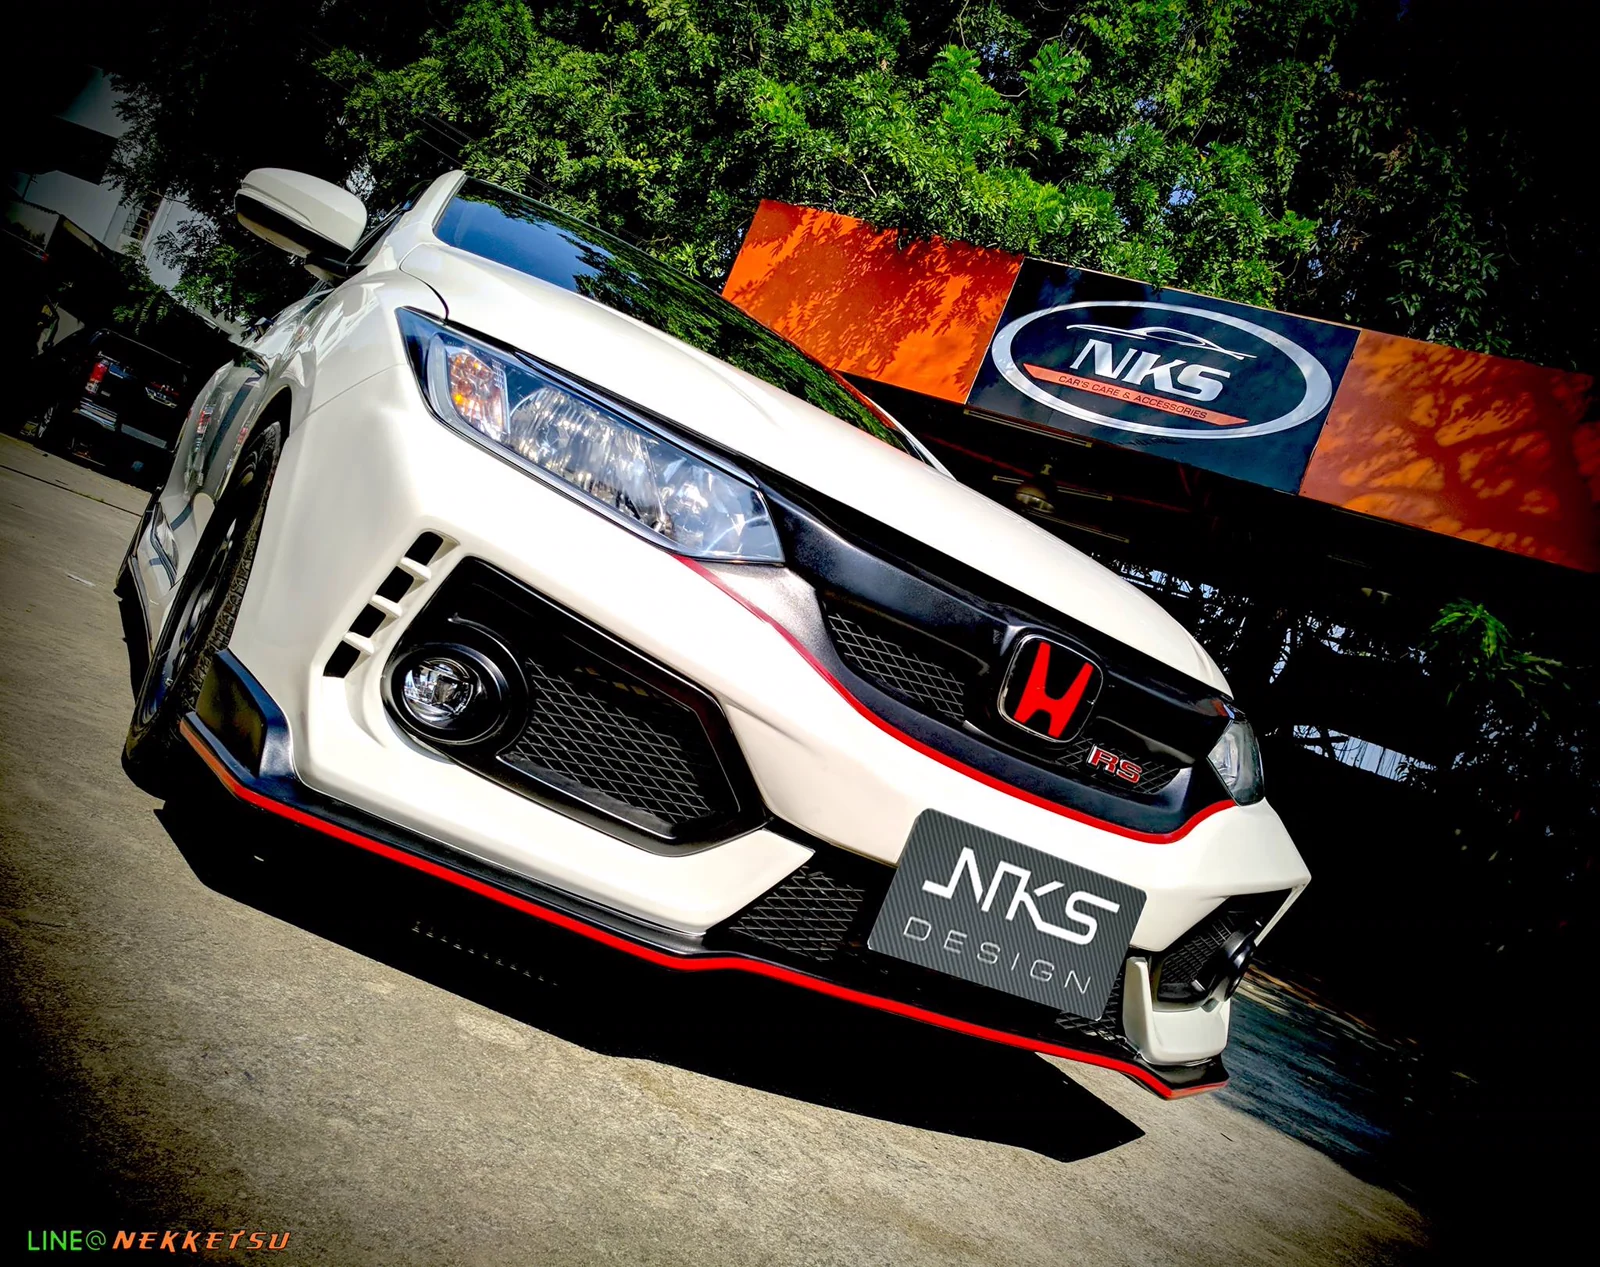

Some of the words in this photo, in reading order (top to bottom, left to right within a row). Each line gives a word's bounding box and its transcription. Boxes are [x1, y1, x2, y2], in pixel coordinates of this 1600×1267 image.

[1058, 375, 1090, 389] CAR'S
[1091, 383, 1120, 397] CARE
[1122, 390, 1131, 400] &
[1134, 395, 1208, 419] ACCESSORIES
[1070, 338, 1231, 401] NKS
[1087, 744, 1143, 784] RS
[922, 846, 1120, 945] NKS
[903, 916, 1091, 995] DESIGN
